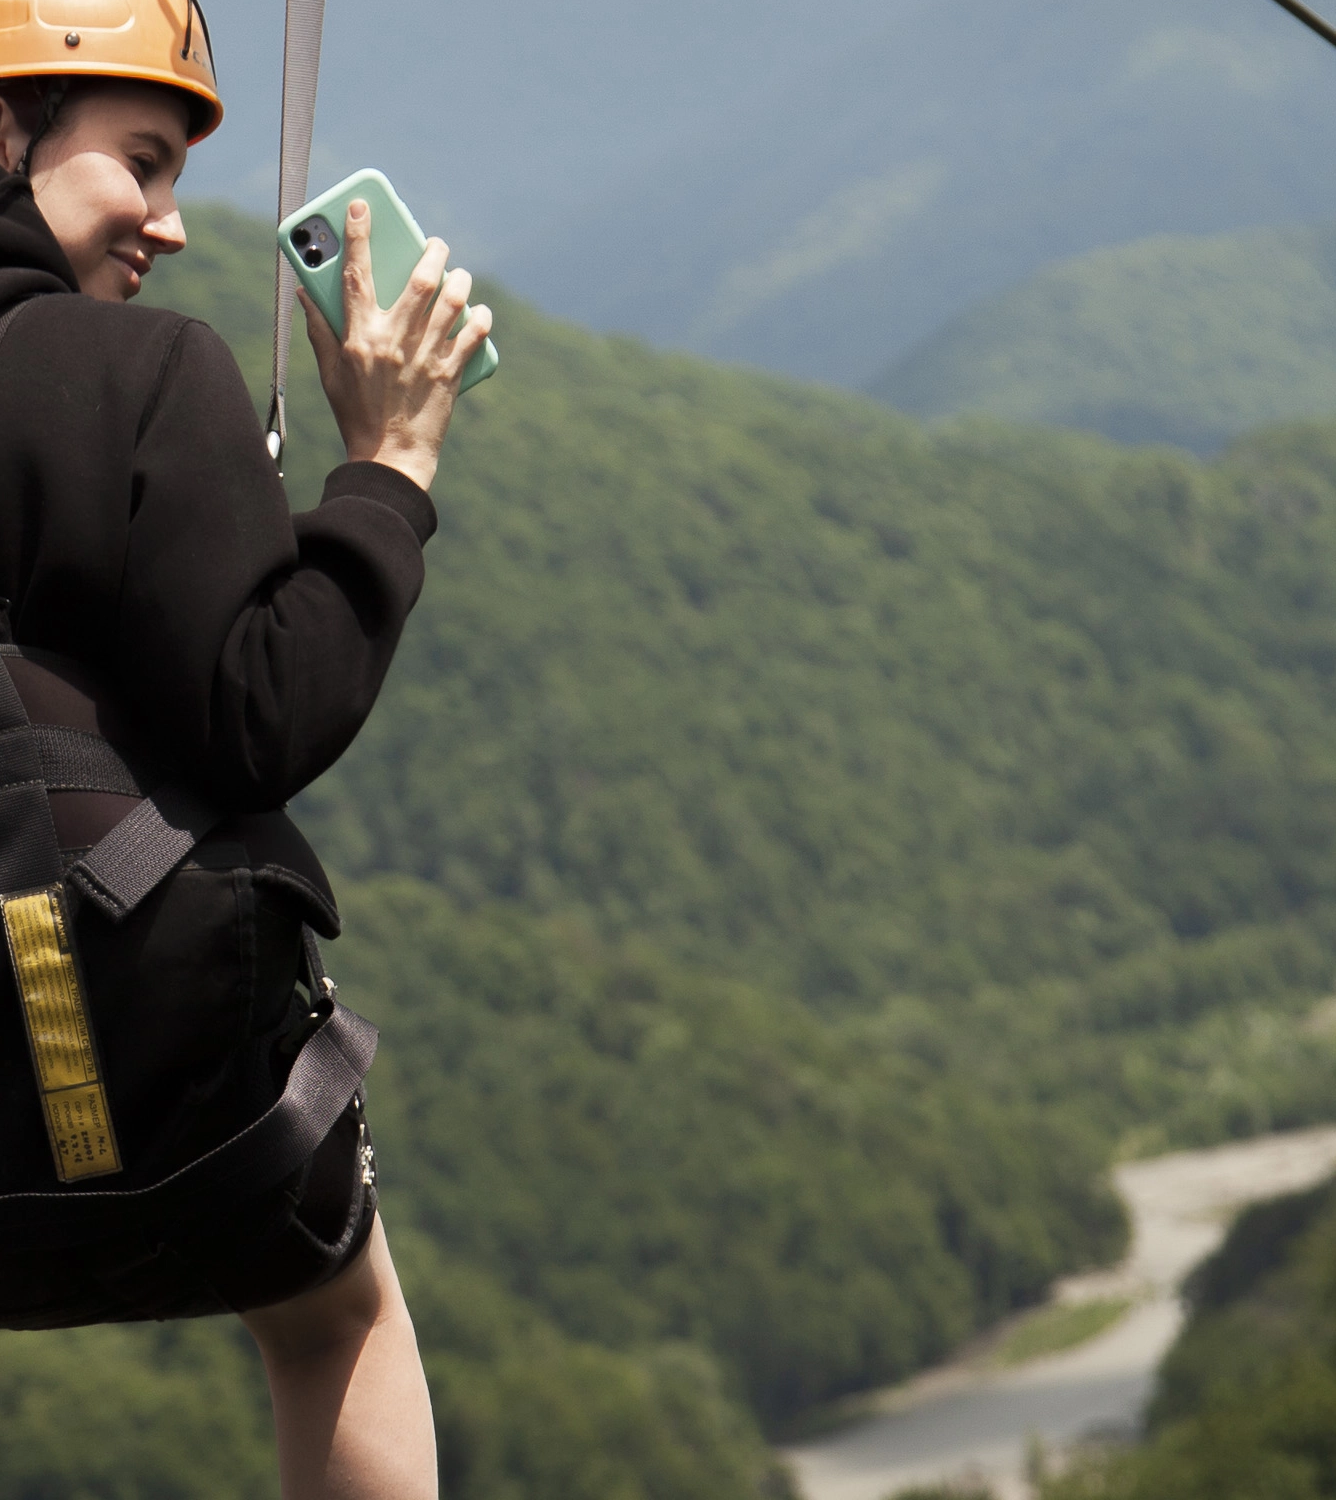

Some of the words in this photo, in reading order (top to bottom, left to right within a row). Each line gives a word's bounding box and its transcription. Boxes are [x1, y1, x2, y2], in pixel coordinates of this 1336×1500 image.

[65, 961, 76, 984] РИСК
[70, 986, 83, 1016] ТРАВМ
[76, 1017, 87, 1036] ИЛИ
[81, 1038, 95, 1073] СМЕРТИ
[86, 1093, 101, 1128] РАЗМЕР
